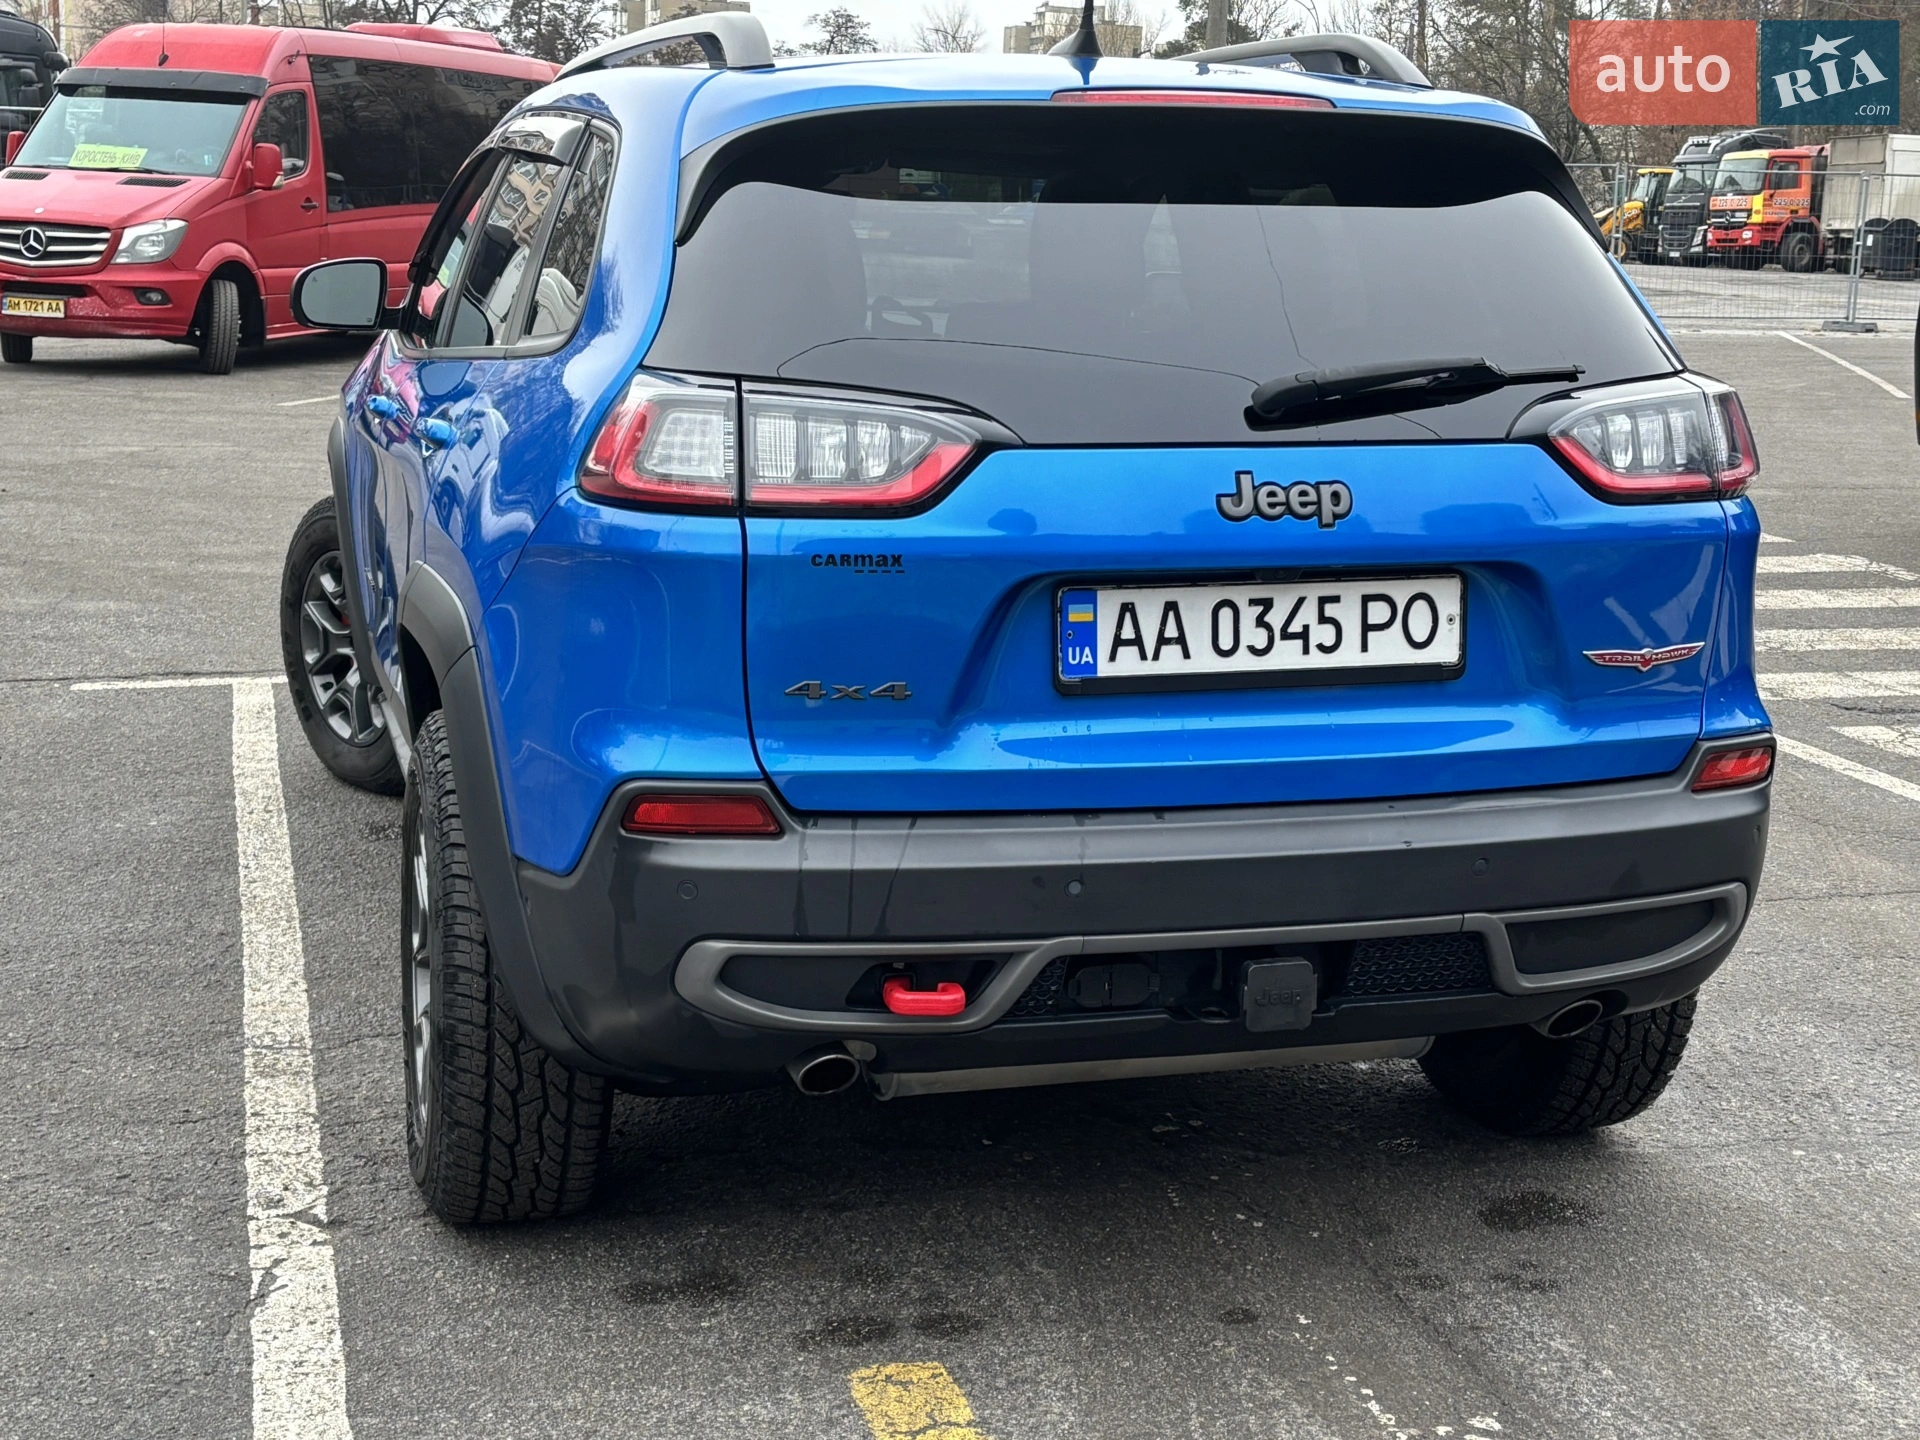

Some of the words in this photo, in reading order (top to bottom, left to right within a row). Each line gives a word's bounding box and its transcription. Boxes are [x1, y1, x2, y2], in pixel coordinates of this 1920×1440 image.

[8, 299, 20, 310] AM
[23, 300, 44, 311] 1721
[47, 302, 61, 313] AA
[1216, 470, 1353, 529] Jeep
[1107, 600, 1192, 663] AA
[1210, 594, 1344, 659] 0345
[1360, 591, 1440, 654] PO
[1067, 645, 1095, 665] UA
[784, 680, 912, 700] 4x4
